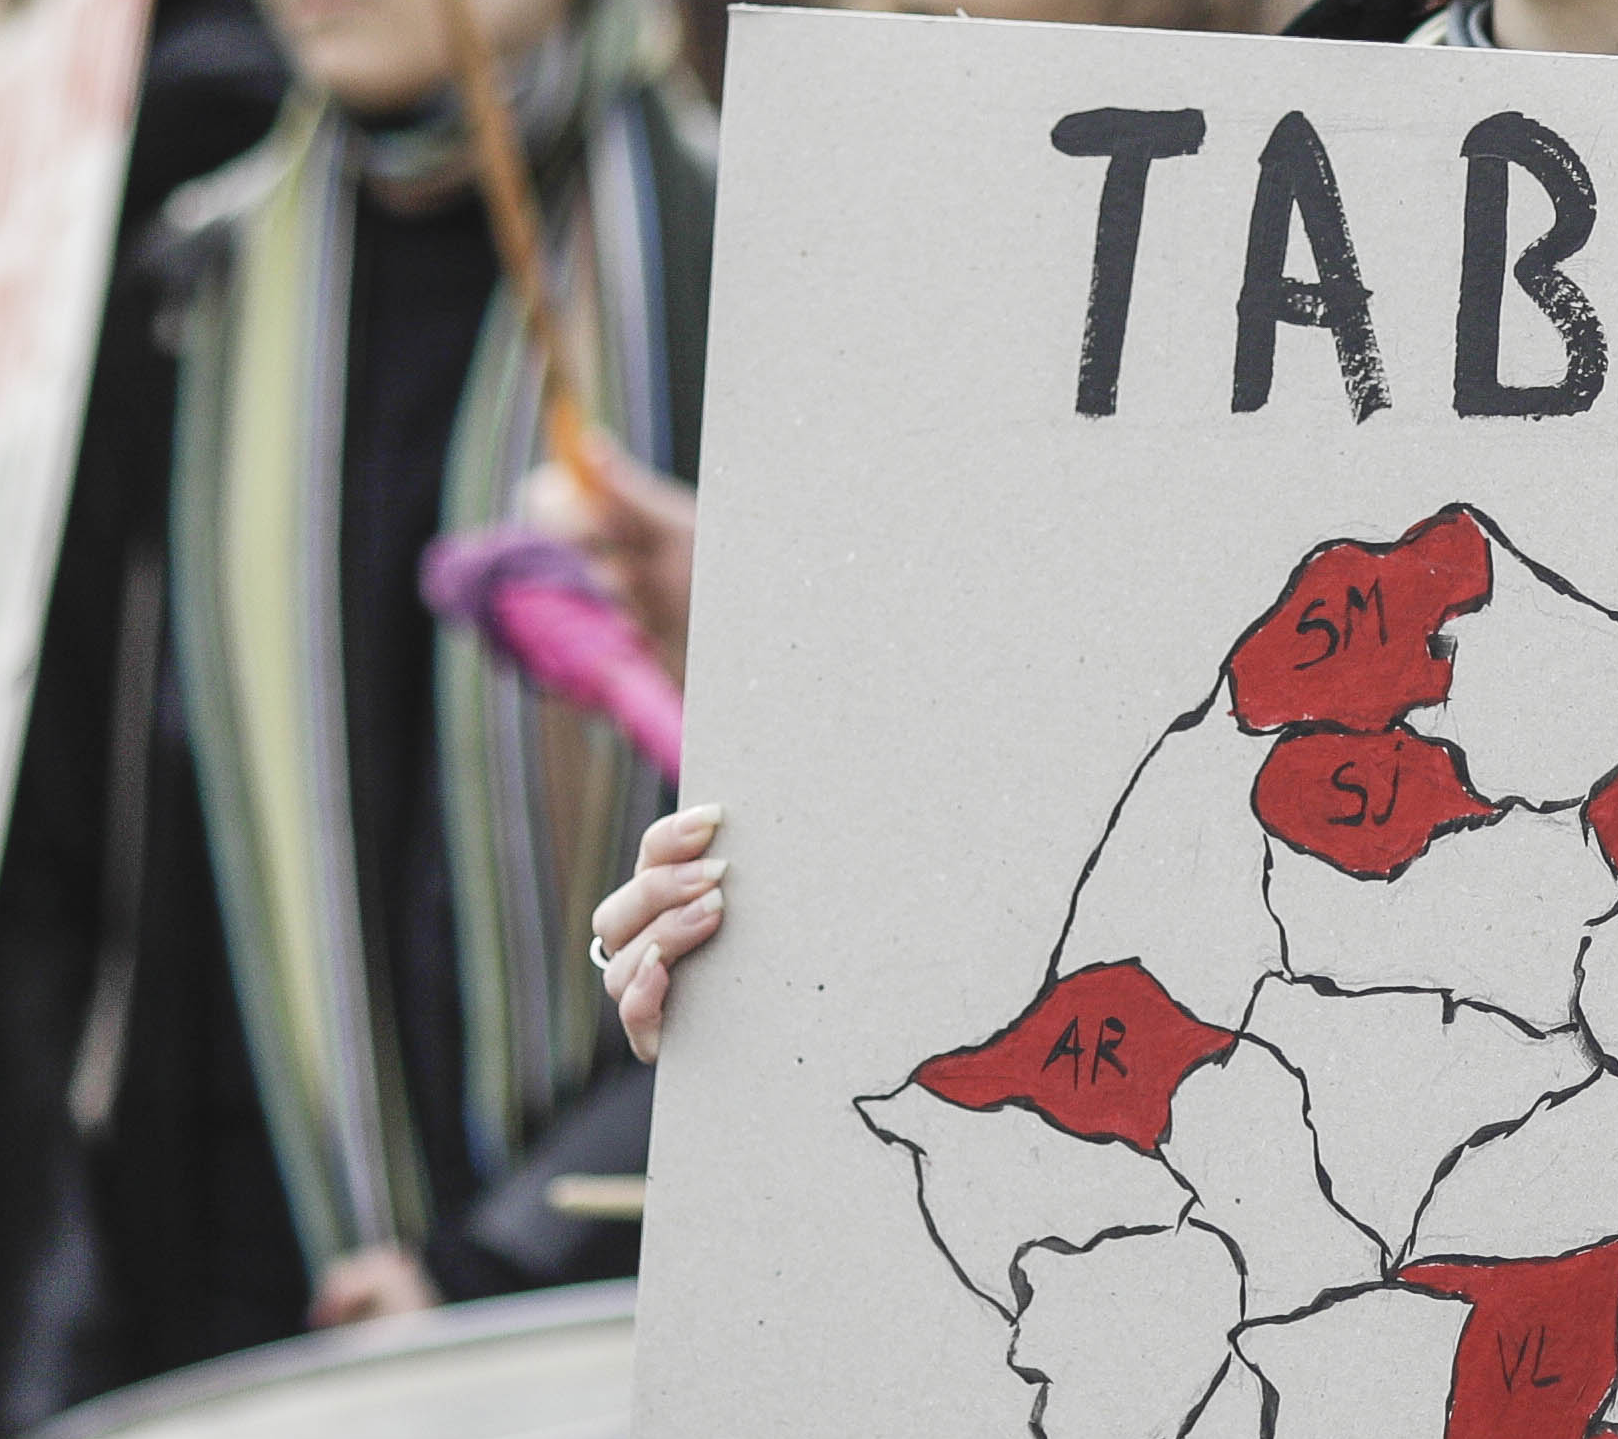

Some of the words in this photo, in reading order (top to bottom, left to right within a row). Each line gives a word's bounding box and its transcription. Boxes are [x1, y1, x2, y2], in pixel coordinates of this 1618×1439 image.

[1294, 578, 1387, 670] SM
[1327, 740, 1405, 826] SJ
[1040, 1015, 1130, 1091] AR
[1495, 1323, 1562, 1395] VL
